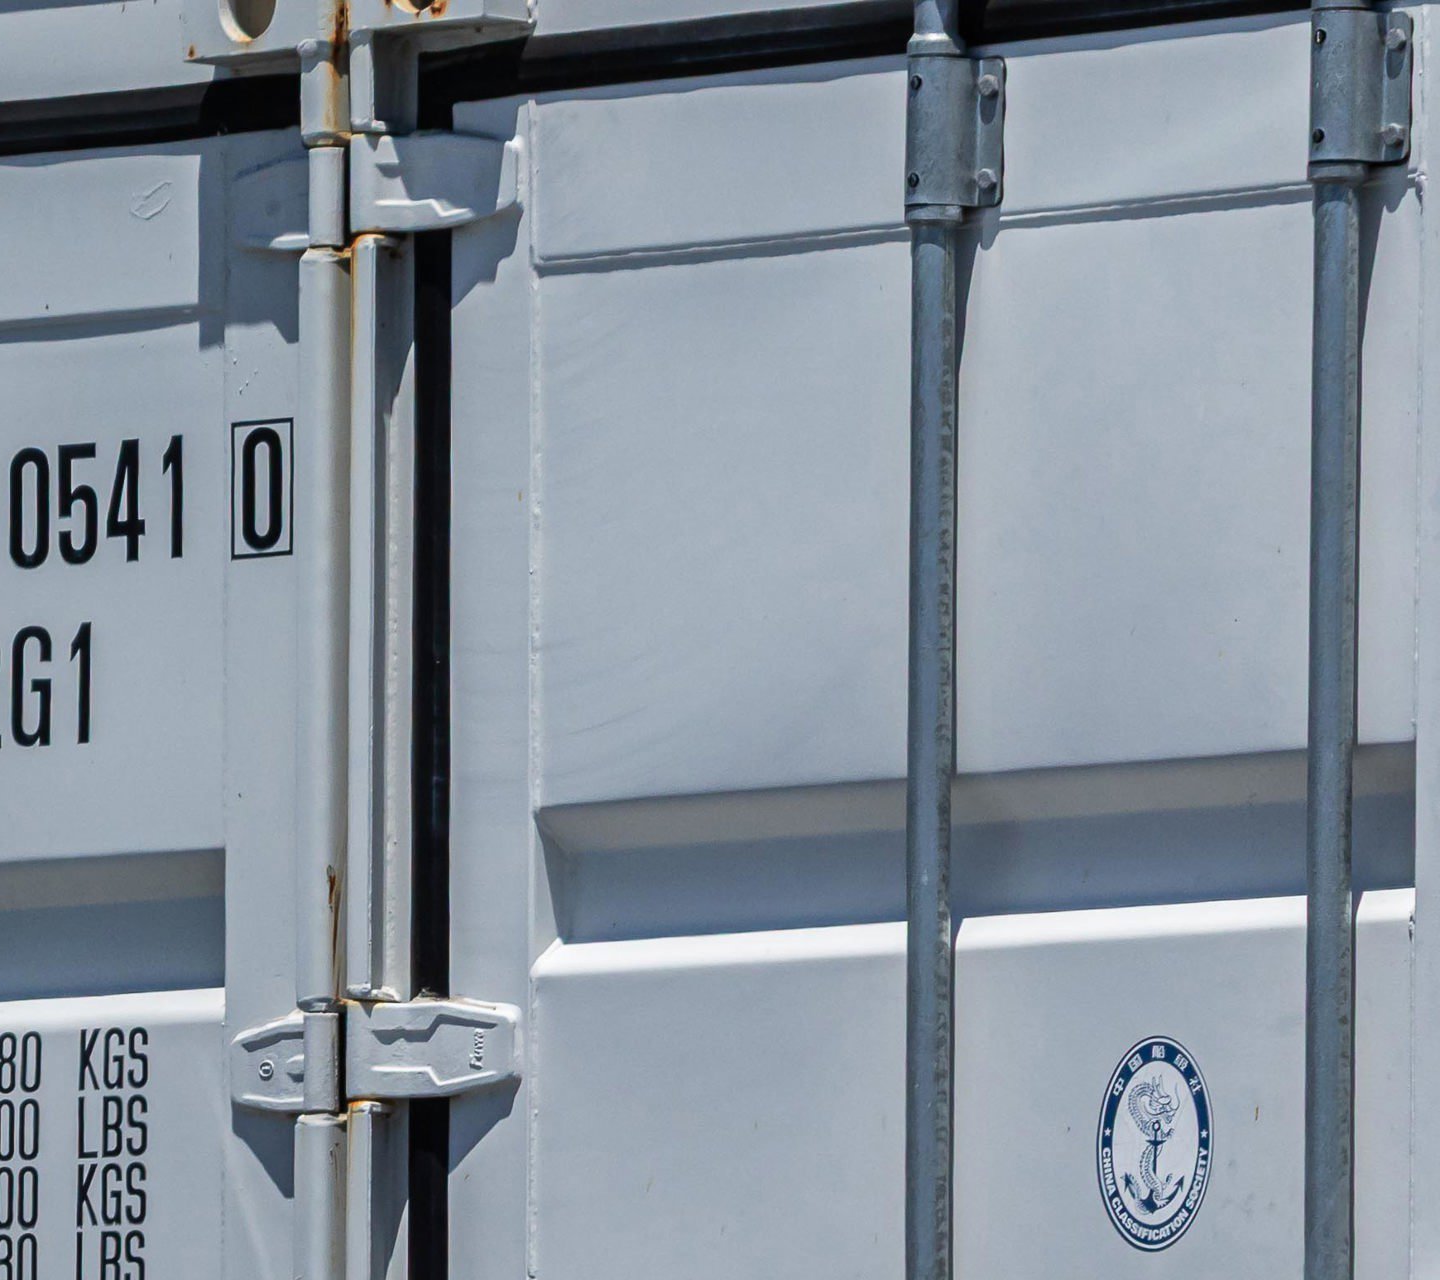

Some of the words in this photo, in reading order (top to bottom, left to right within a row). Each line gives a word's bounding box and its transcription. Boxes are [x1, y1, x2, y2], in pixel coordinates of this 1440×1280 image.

[79, 1027, 149, 1092] KGS
[77, 1094, 149, 1160] LBS
[76, 1162, 148, 1227] KGS
[1101, 1147, 1116, 1197] CHINA
[1110, 1198, 1190, 1242] CLASSIFICATION
[1184, 1146, 1210, 1210] SOCIETY
